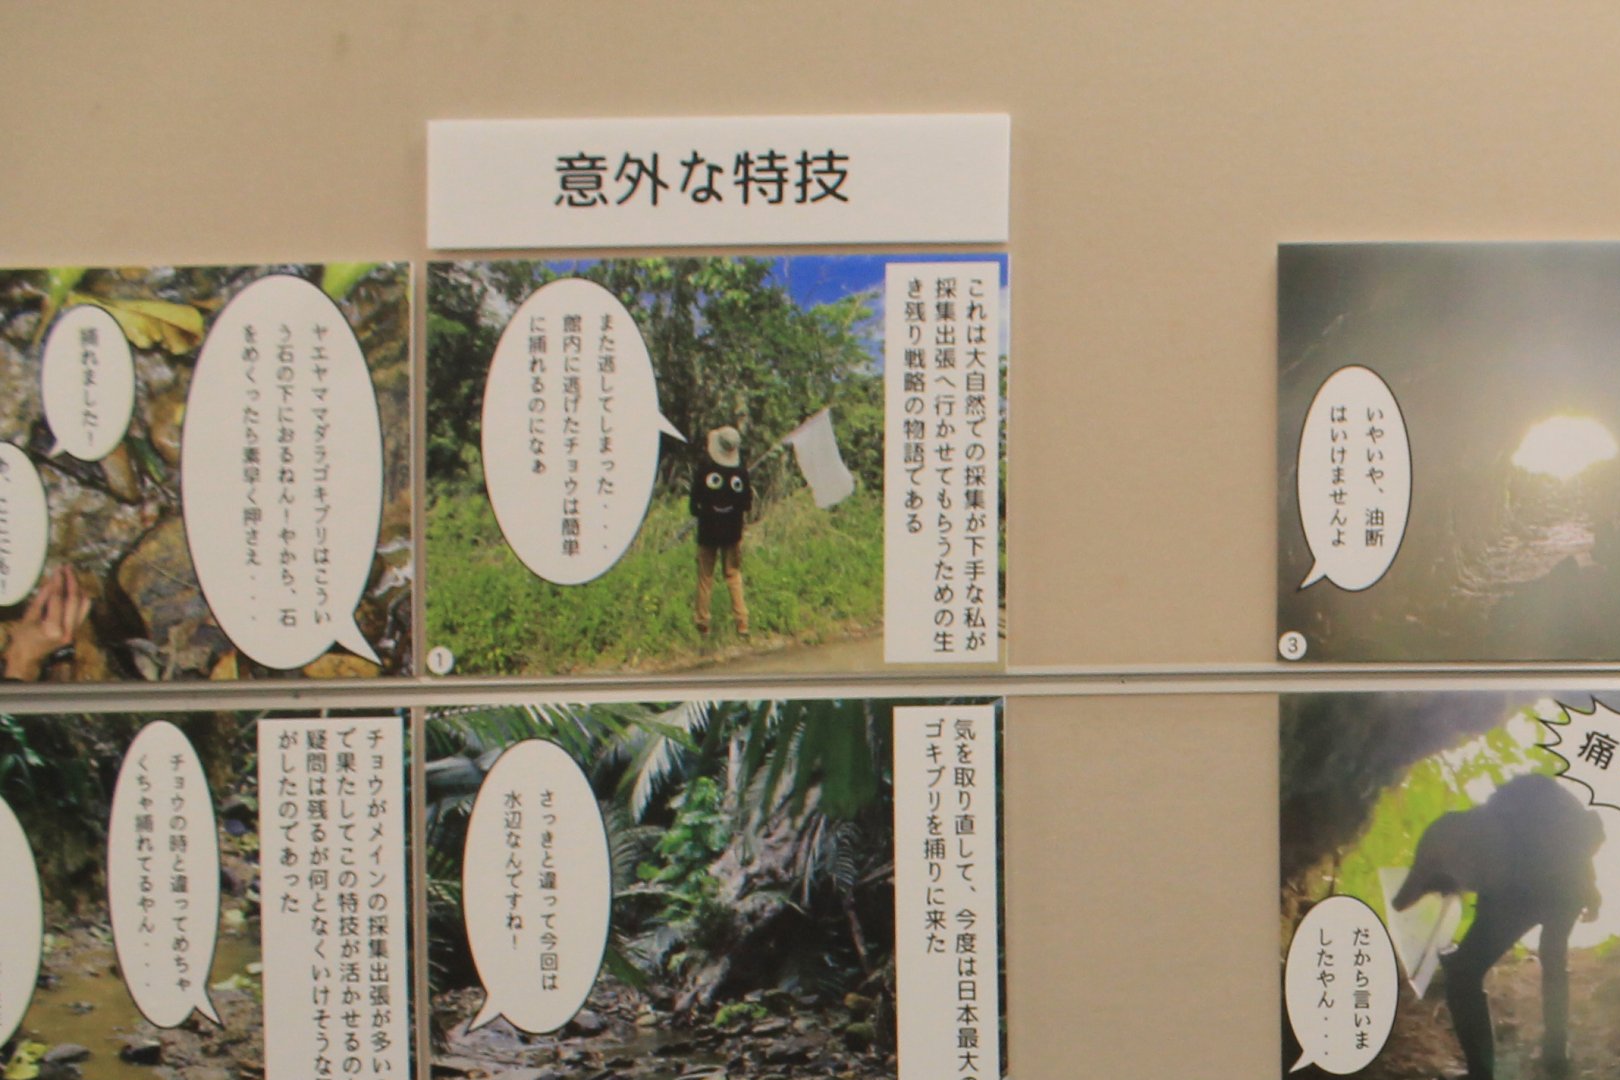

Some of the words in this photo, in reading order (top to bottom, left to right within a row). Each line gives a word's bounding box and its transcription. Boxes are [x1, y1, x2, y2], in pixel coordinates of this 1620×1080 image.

[554, 148, 850, 209] 意外な特技
[527, 316, 548, 475] に捕れるのになぁ
[561, 313, 583, 558] 館内に逃げたチョウは簡単
[902, 276, 927, 535] き残り戦略の物語である
[932, 276, 957, 653] 採集出張へ行かせてもらうための生
[963, 278, 988, 652] これは大自然での採集が下手な私が
[1328, 405, 1348, 548] はいけませんよ
[1364, 407, 1385, 548] いやいや、油断
[436, 652, 443, 668] 1
[1287, 636, 1299, 654] 3
[134, 753, 156, 988] くちゃ捕れてるやん・・・
[168, 753, 192, 992] チョウの時と違ってめちゃ
[277, 729, 301, 914] がしたのであった
[503, 789, 524, 950] 水辺なんですね！
[538, 789, 559, 992] さっきと違って今回は
[923, 717, 947, 955] ゴキブリを捕りに来た
[1352, 927, 1372, 1051] だから言いま
